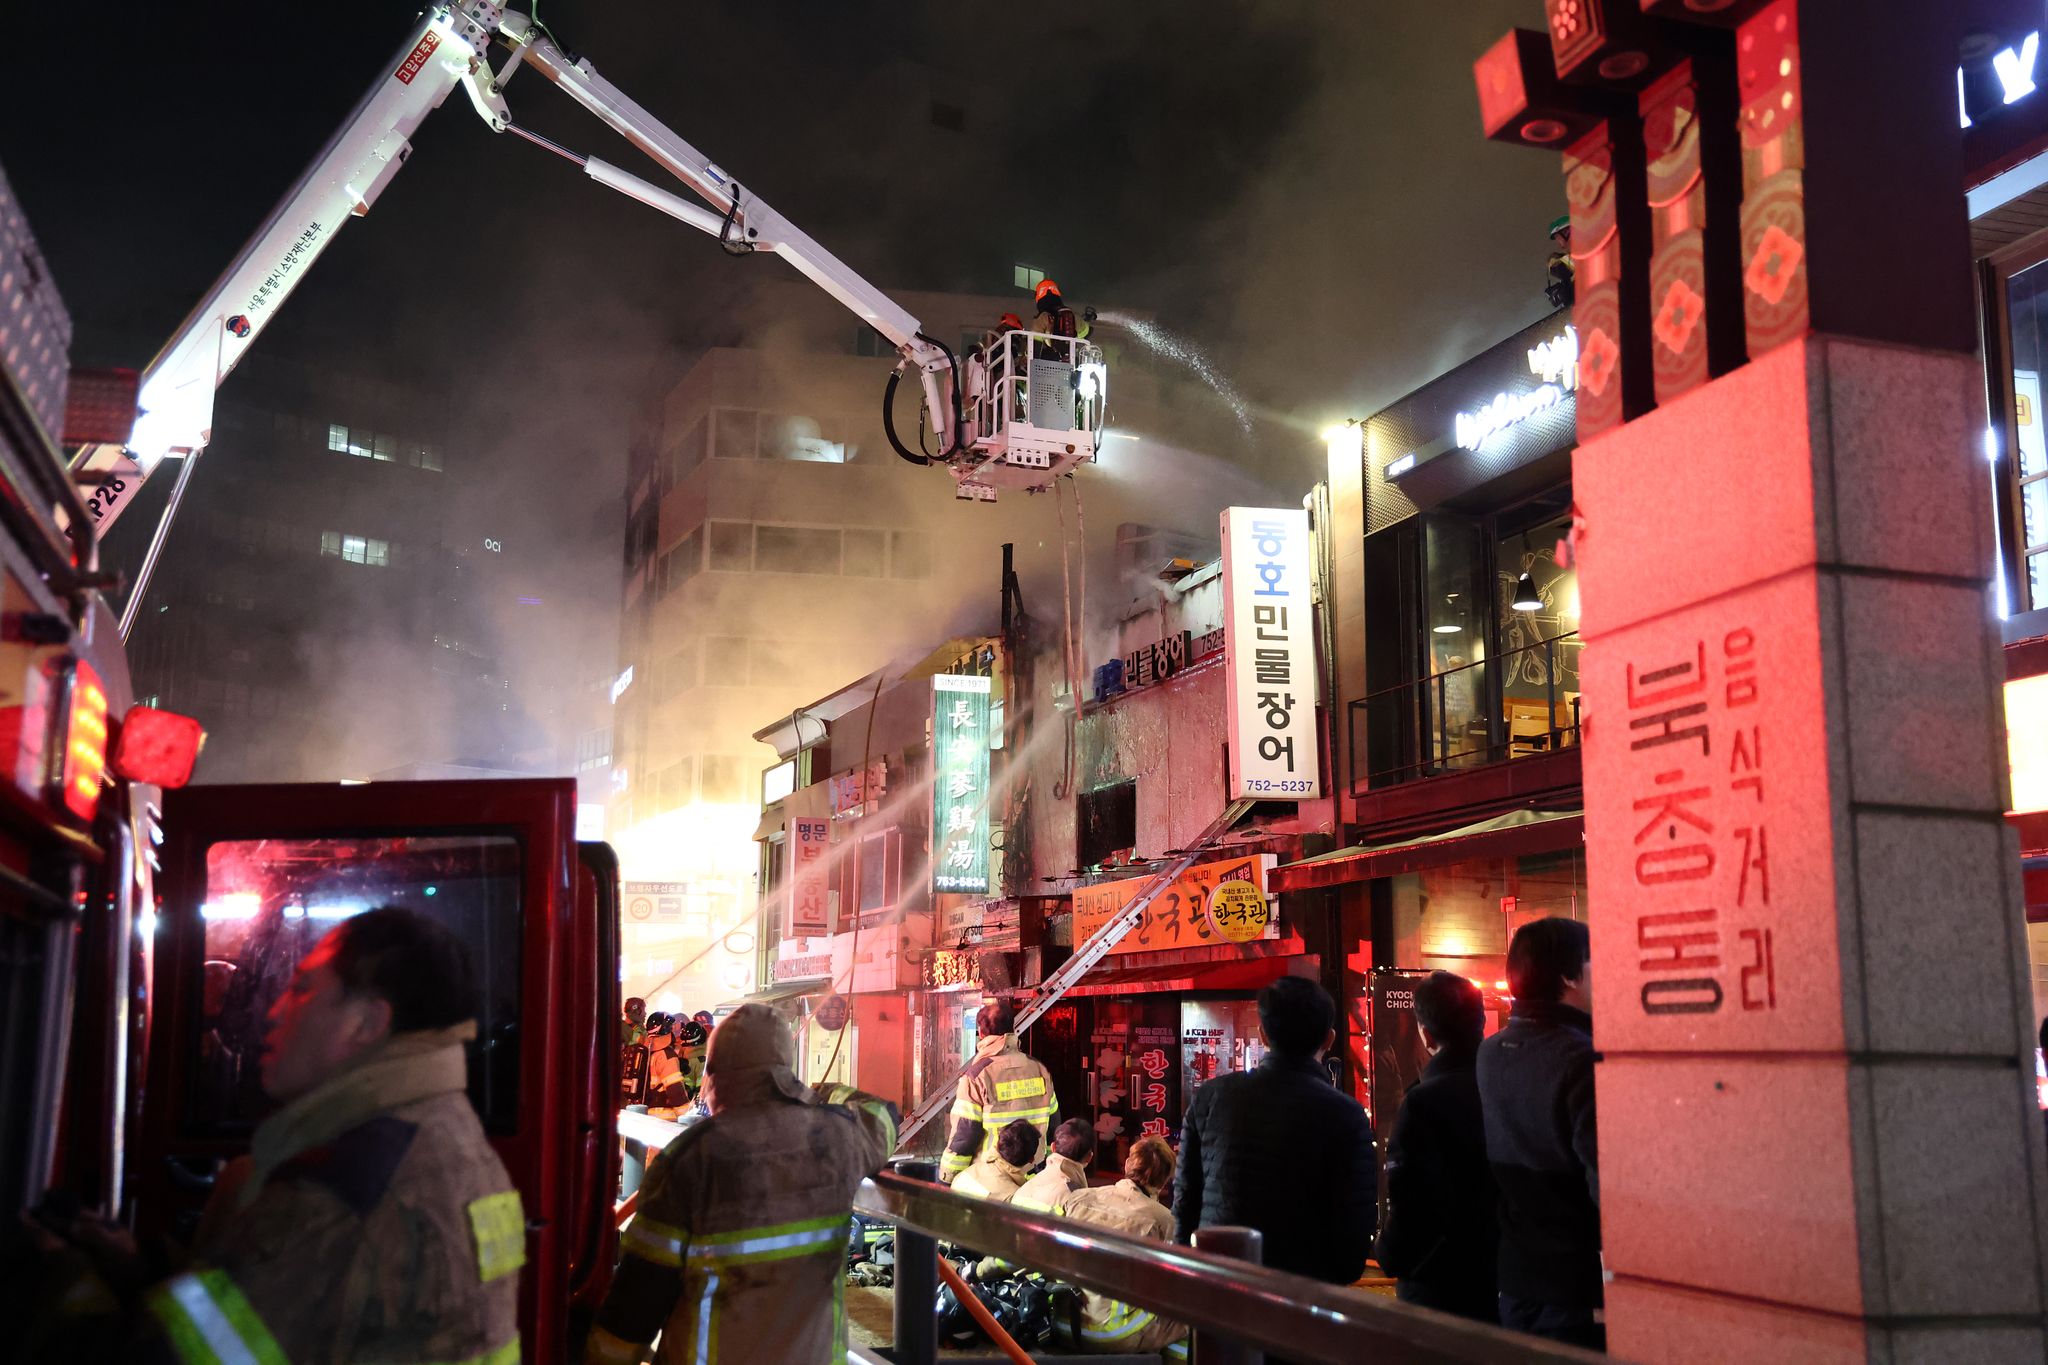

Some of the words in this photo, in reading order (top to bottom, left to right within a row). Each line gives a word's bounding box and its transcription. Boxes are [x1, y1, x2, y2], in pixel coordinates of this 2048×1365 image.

[397, 32, 442, 82] 고압선주의
[248, 269, 285, 312] 서울특별시
[281, 222, 322, 273] 소방재난본부
[1125, 630, 1191, 690] 민물장어
[1246, 780, 1313, 792] 752-5237
[798, 823, 827, 842] 명문
[1723, 627, 1776, 1012] 음식거리
[634, 903, 648, 913] 20
[1077, 896, 1094, 916] 국내산
[1213, 901, 1266, 925] 한국관
[1140, 1050, 1170, 1138] 한국관
